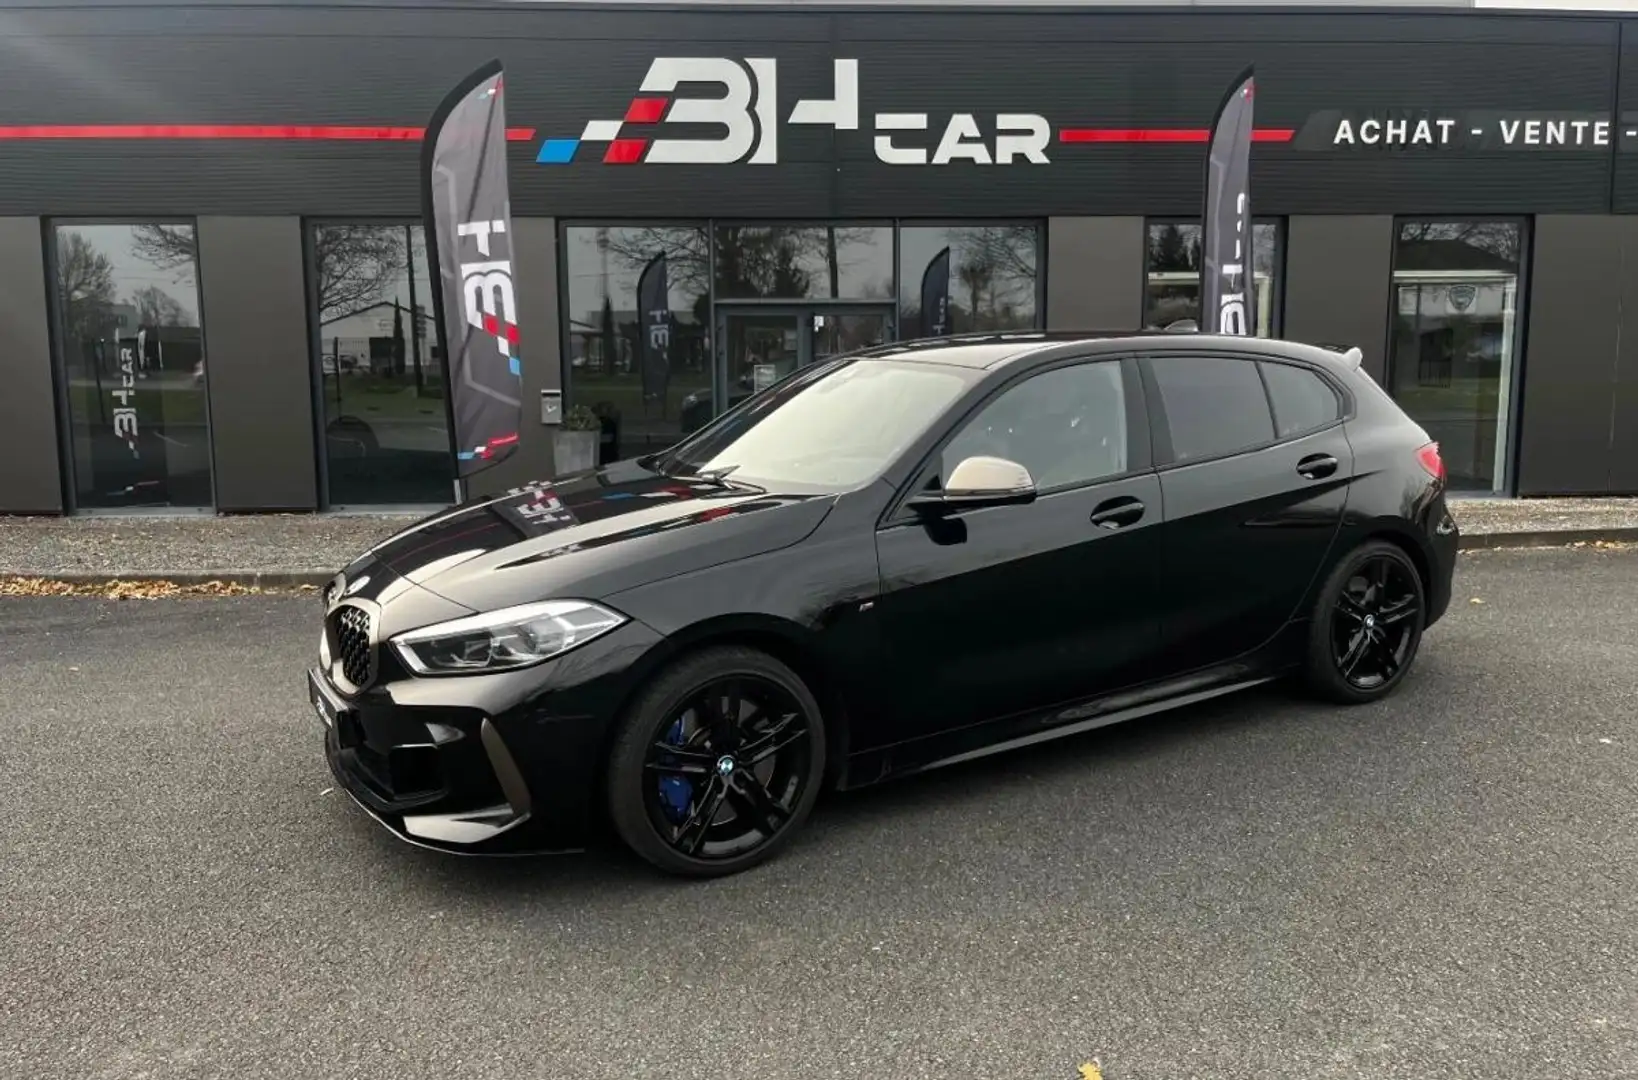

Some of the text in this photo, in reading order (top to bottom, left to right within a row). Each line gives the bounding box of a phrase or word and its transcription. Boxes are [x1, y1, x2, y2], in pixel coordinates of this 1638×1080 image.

[637, 57, 1051, 165] BH CAR
[1333, 119, 1456, 145] ACHAT
[1499, 120, 1610, 145] VENTE
